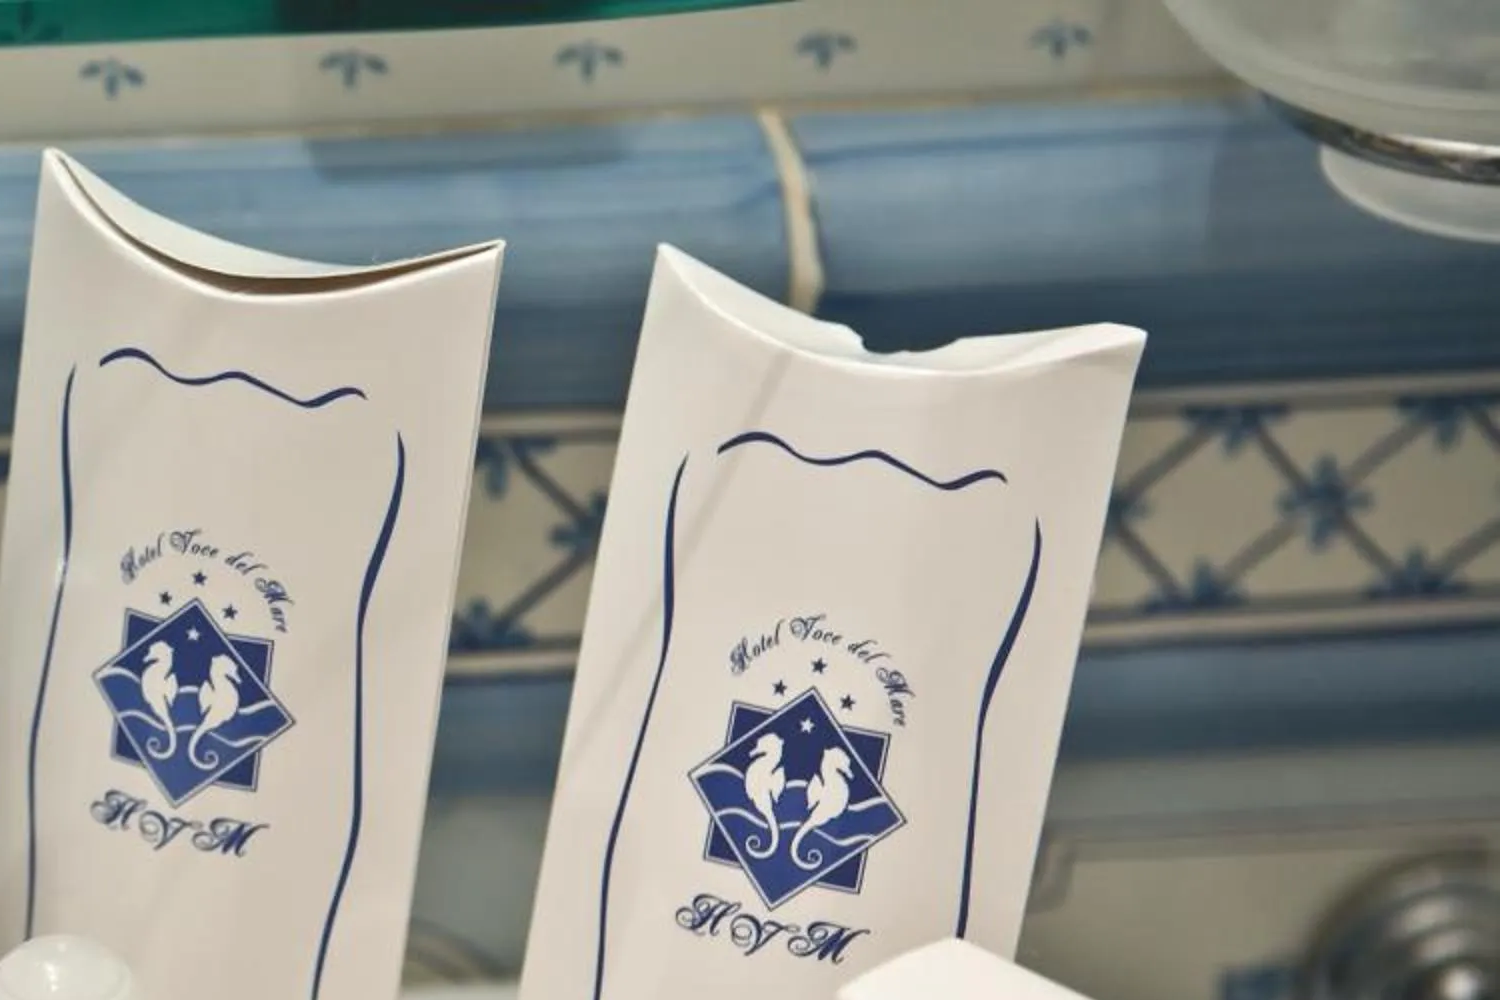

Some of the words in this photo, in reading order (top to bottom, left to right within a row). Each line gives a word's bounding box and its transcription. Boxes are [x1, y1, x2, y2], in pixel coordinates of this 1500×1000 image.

[728, 617, 786, 677] Hotel
[847, 638, 892, 665] del
[875, 666, 916, 729] Mare
